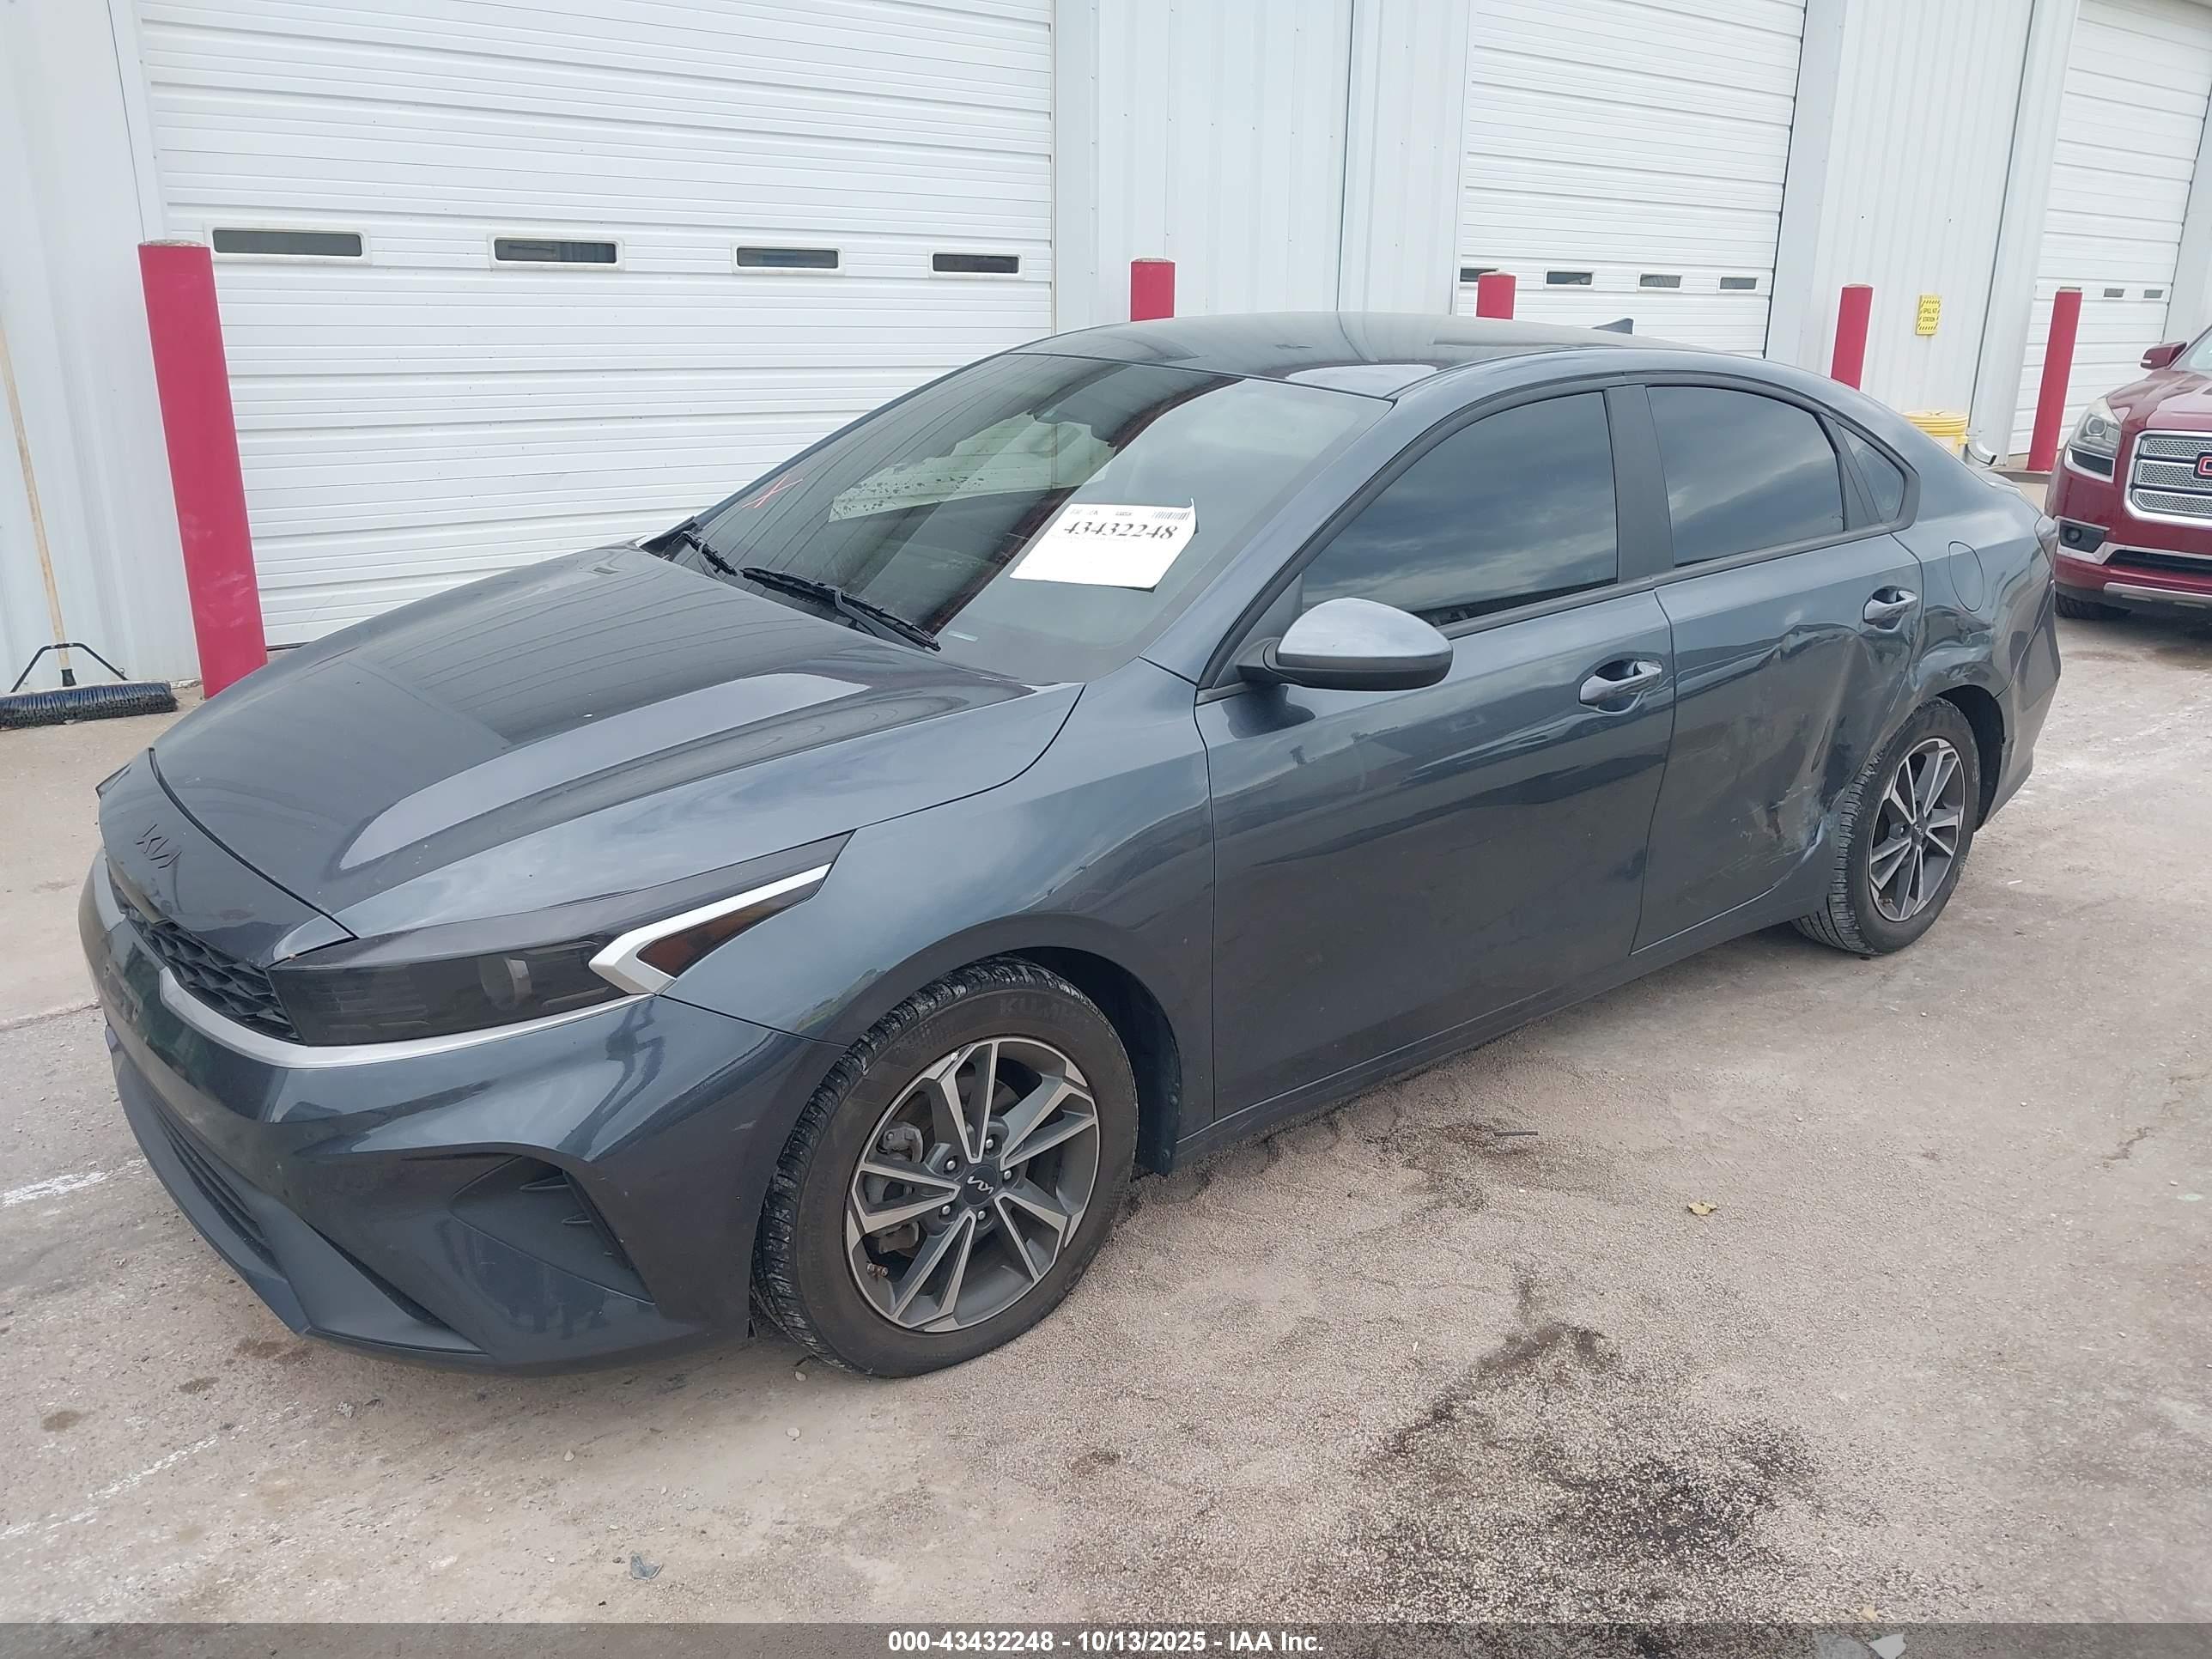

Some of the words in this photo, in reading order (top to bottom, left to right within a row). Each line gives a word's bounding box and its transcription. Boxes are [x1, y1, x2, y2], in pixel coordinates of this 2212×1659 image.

[1064, 521, 1178, 539] 43432248
[136, 823, 182, 869] KIA
[967, 1176, 994, 1194] KIA
